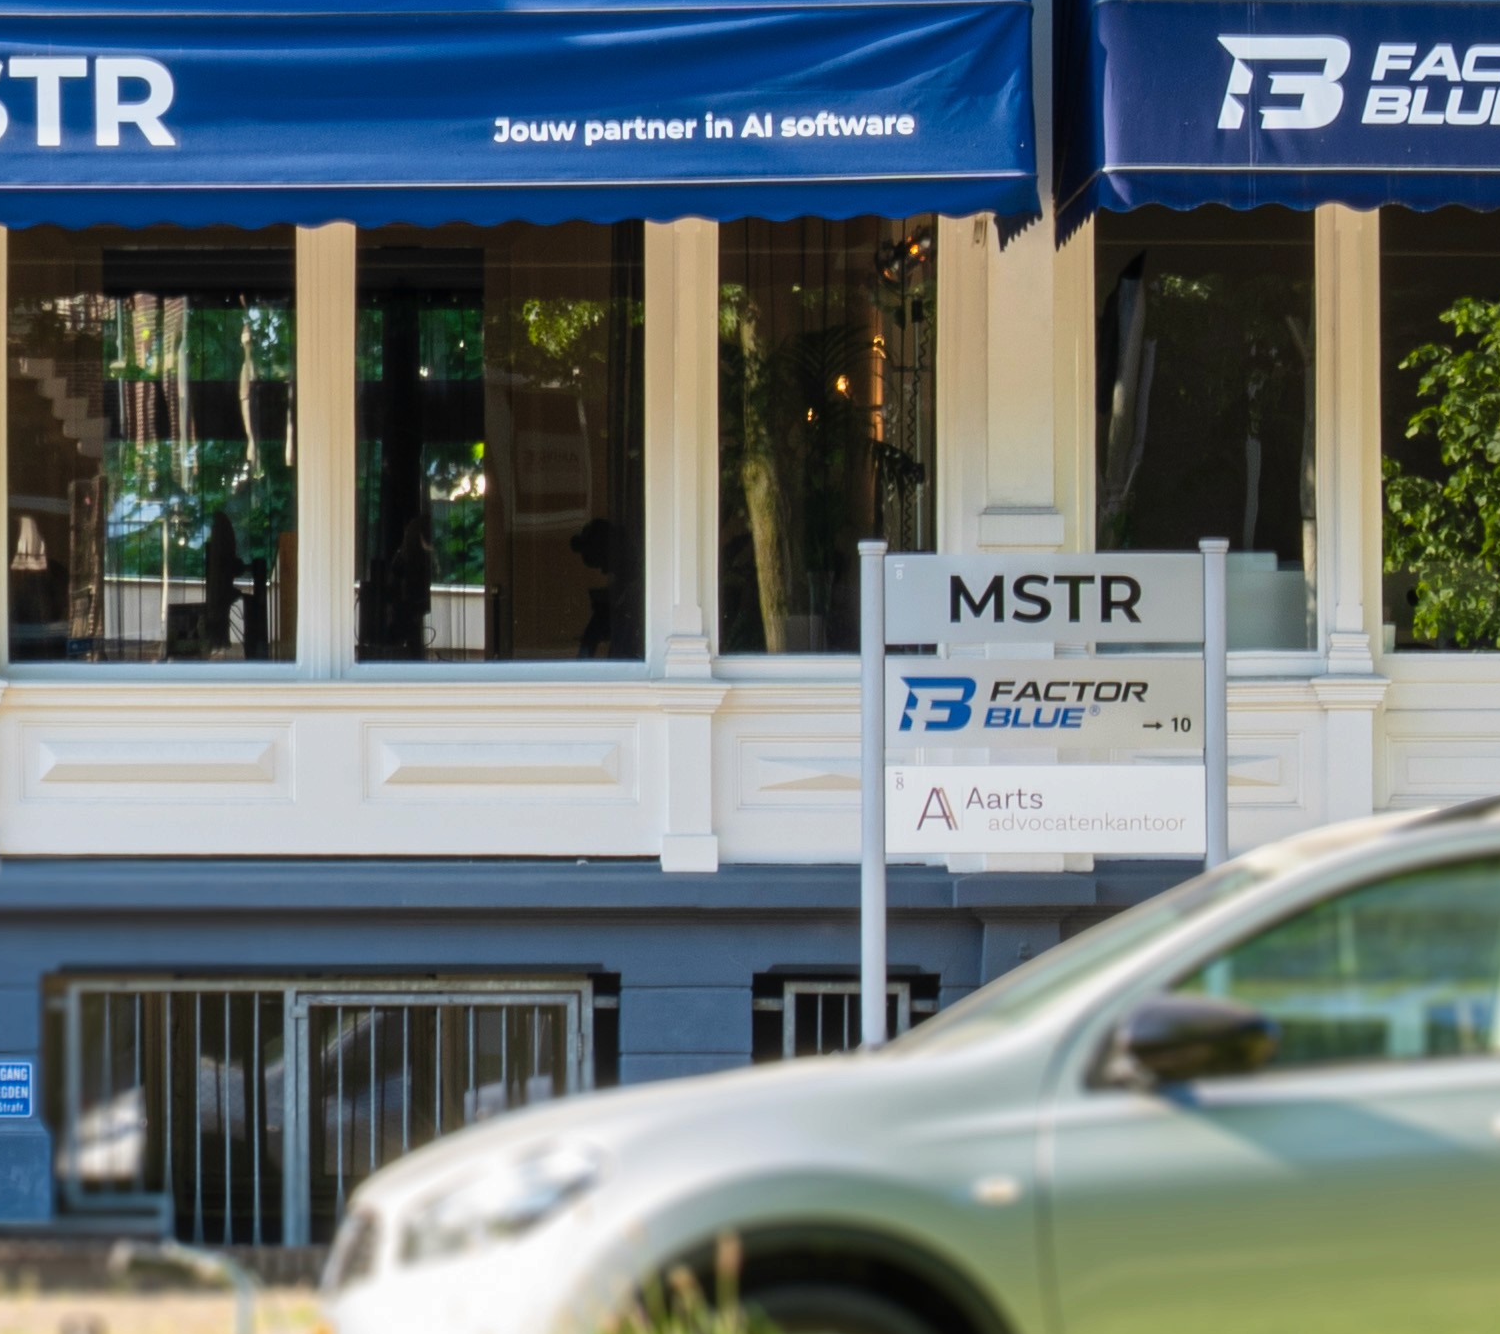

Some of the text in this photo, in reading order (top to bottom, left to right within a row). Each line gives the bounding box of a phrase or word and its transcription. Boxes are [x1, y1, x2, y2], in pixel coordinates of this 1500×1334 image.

[494, 109, 916, 147] Jouw partner in AI software
[949, 574, 1142, 624] MSTR
[989, 681, 1150, 703] FACTOR
[1171, 717, 1192, 733] 10
[965, 786, 1044, 810] Aarts
[988, 811, 1188, 832] advocatenkantoor
